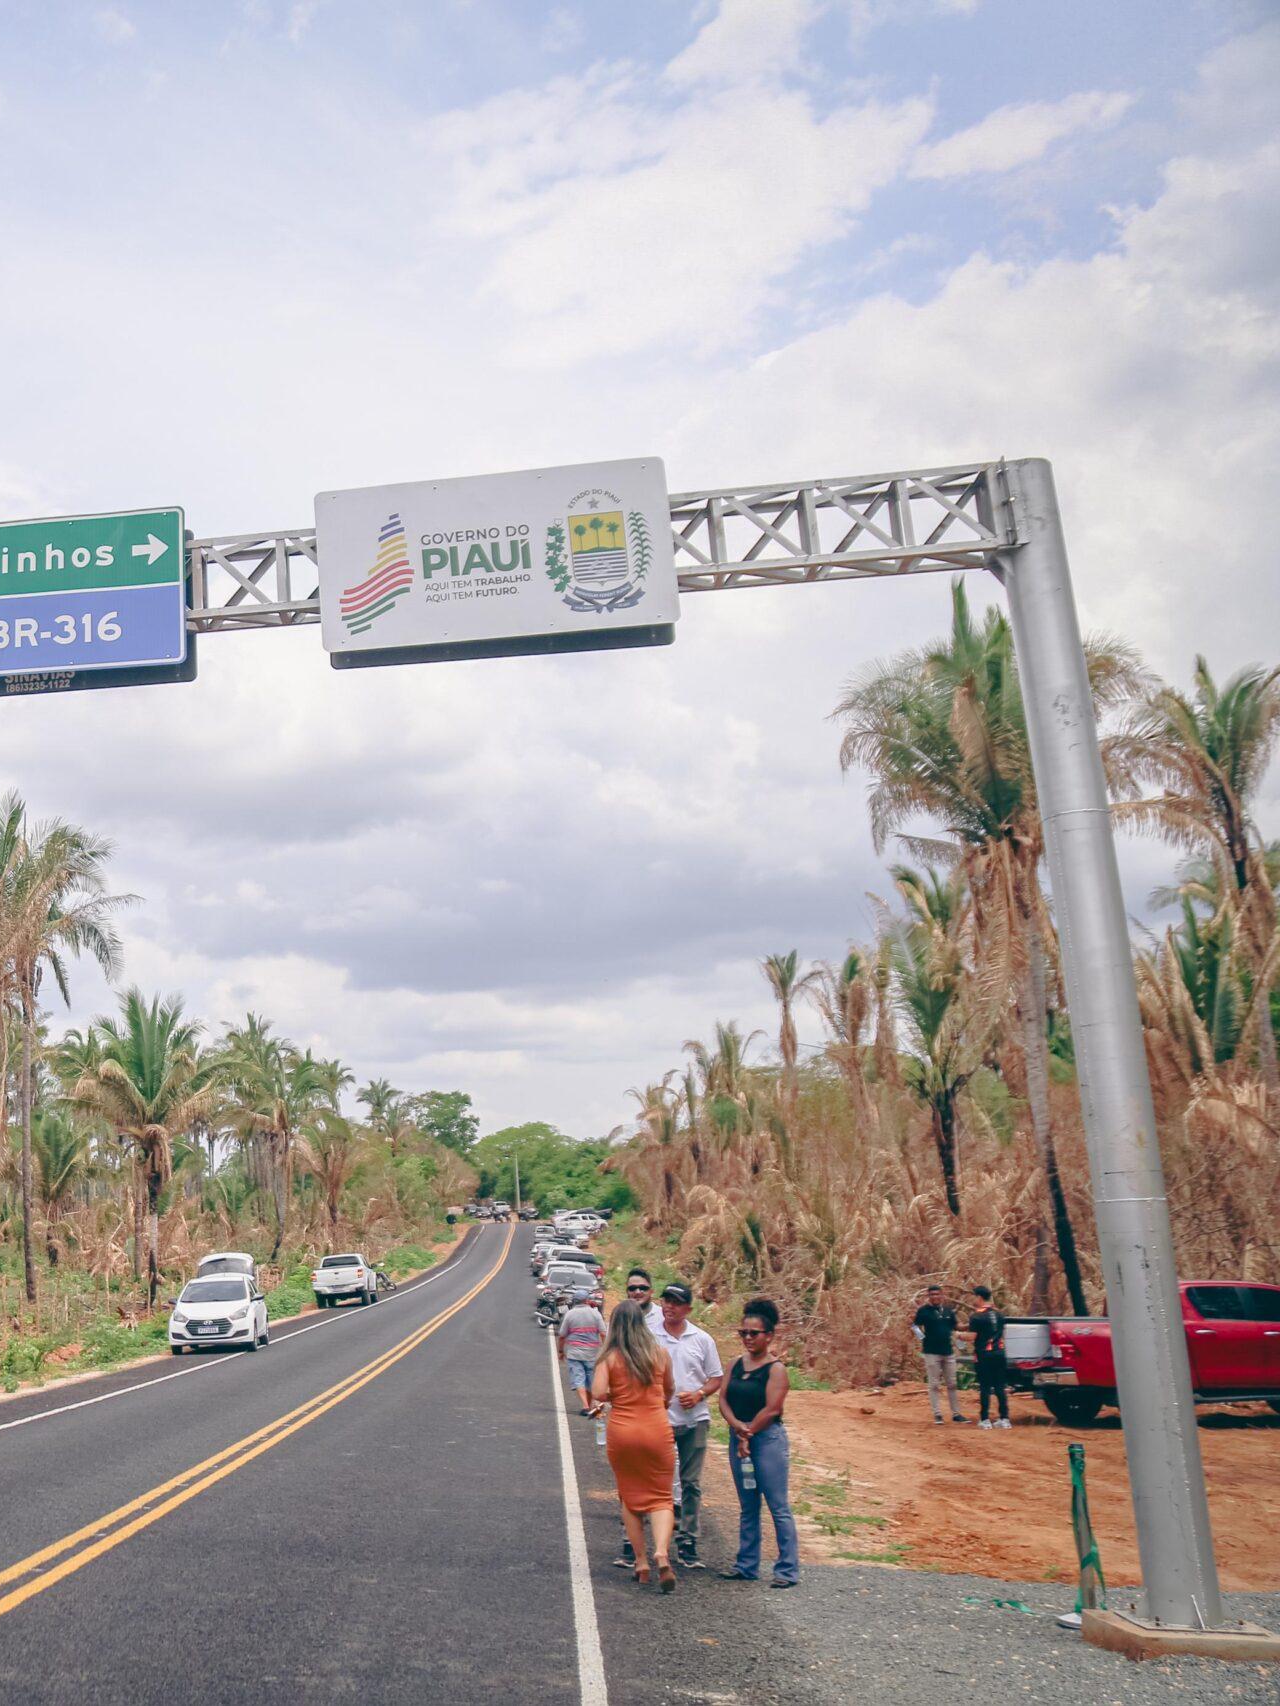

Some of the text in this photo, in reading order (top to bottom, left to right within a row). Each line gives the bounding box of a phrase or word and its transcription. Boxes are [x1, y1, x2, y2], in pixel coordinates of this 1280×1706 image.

[420, 524, 530, 545] GOVERNO DO
[421, 538, 532, 579] PIAUÍ
[424, 581, 449, 592] AQUI
[451, 580, 473, 590] TEM
[425, 586, 520, 603] AQUI TEM FUTURO.
